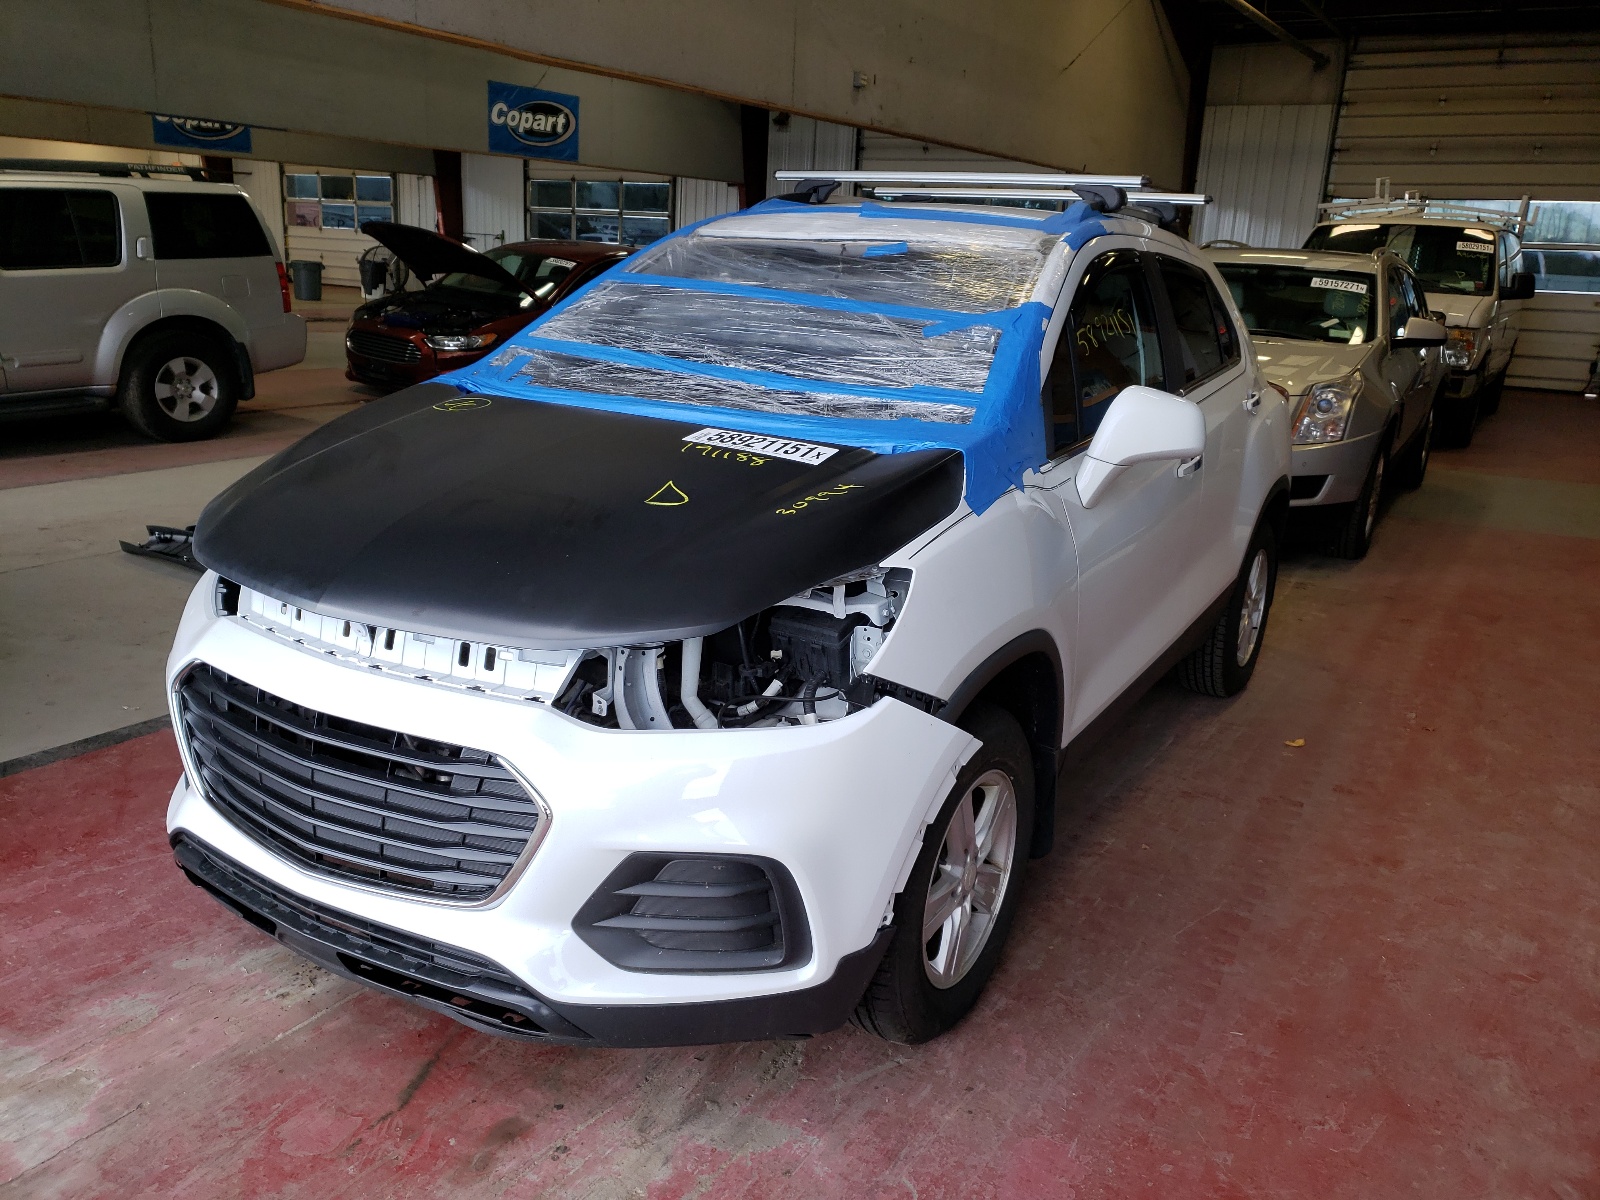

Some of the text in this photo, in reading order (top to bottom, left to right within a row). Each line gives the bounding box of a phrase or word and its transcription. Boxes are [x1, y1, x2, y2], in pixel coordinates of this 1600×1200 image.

[491, 102, 566, 133] Copart
[127, 164, 185, 173] PATHFINDER
[1461, 243, 1492, 251] 58029151
